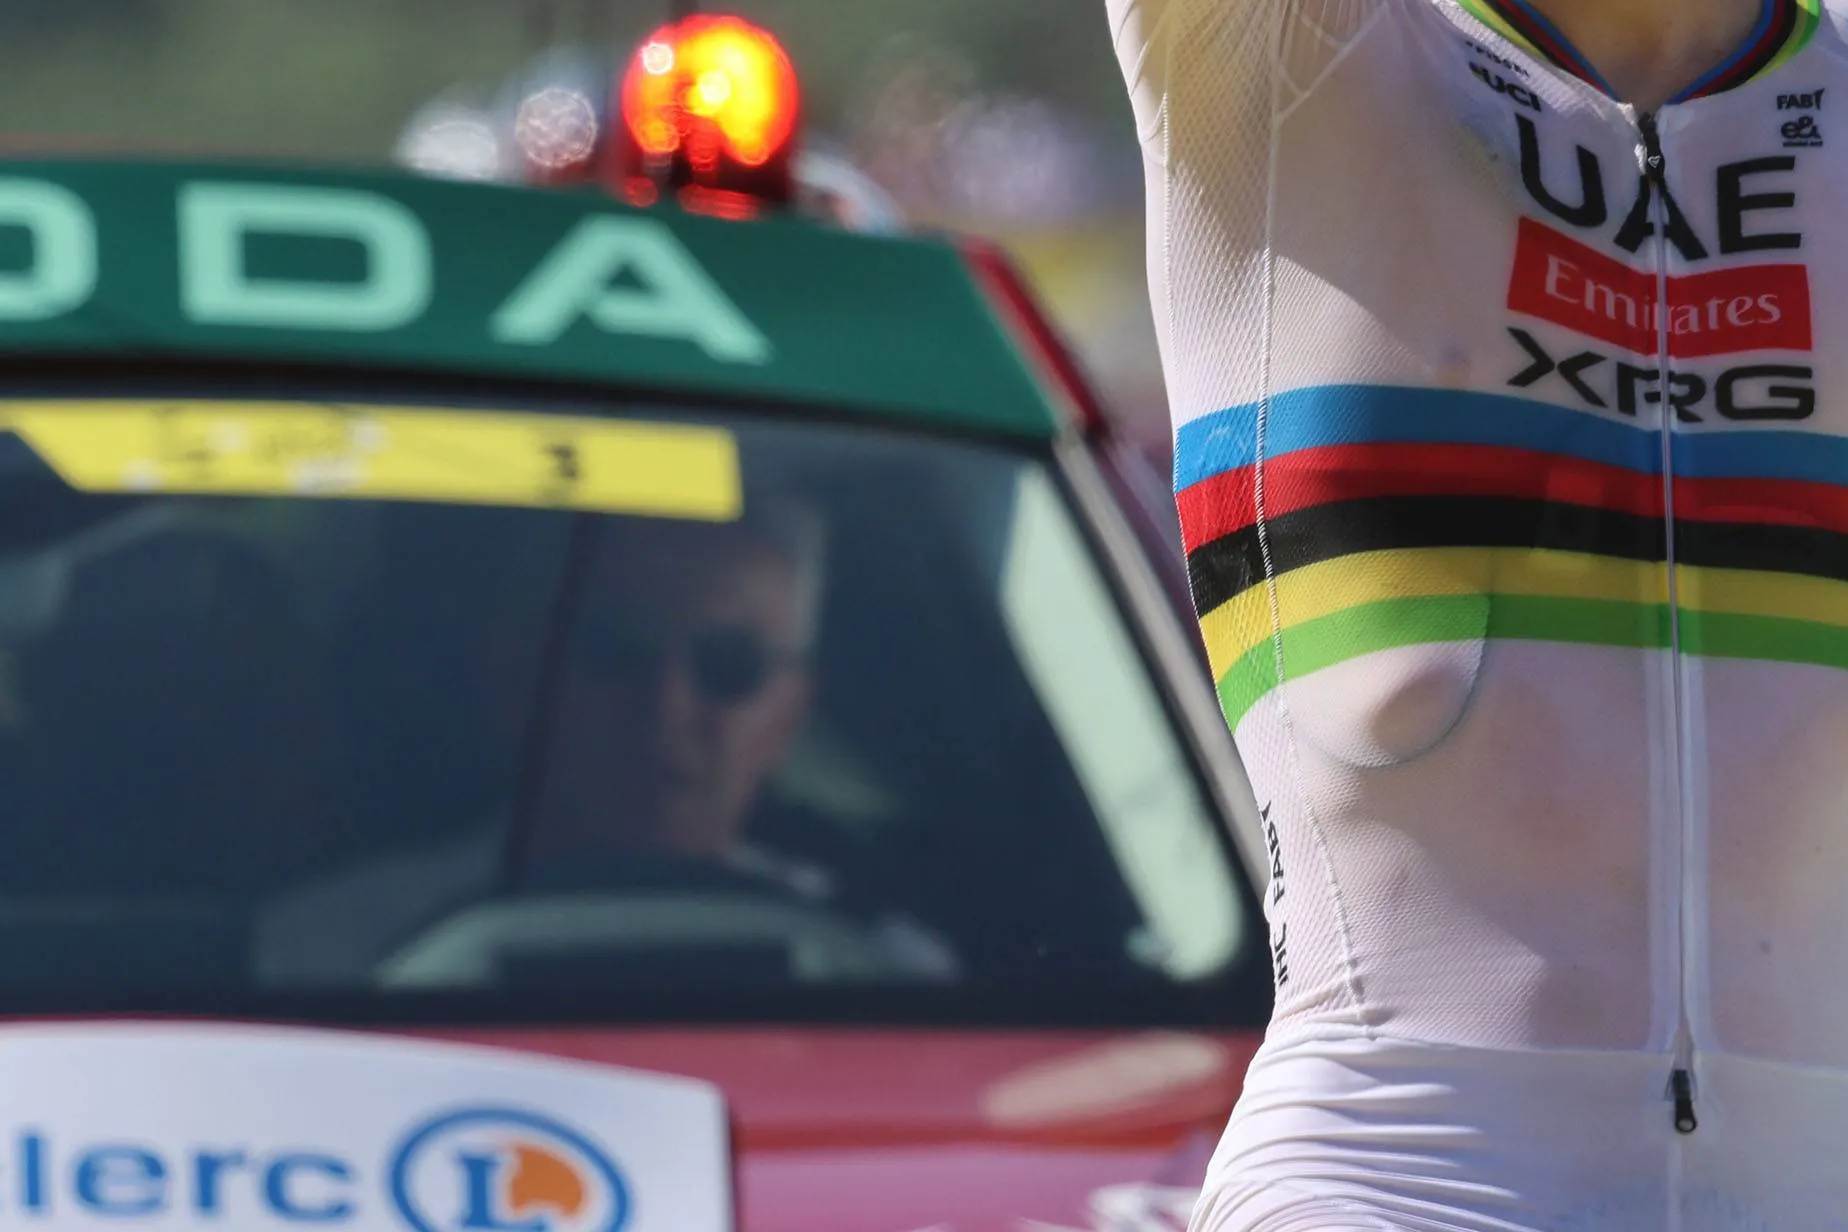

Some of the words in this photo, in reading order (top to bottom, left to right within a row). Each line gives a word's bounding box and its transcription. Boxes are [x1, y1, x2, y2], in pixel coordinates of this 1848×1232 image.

[1480, 67, 1541, 113] UCI
[1515, 112, 1802, 261] UAE
[1545, 252, 1782, 335] Emirates
[1506, 326, 1815, 423] XRG
[0, 1126, 353, 1224] lerc
